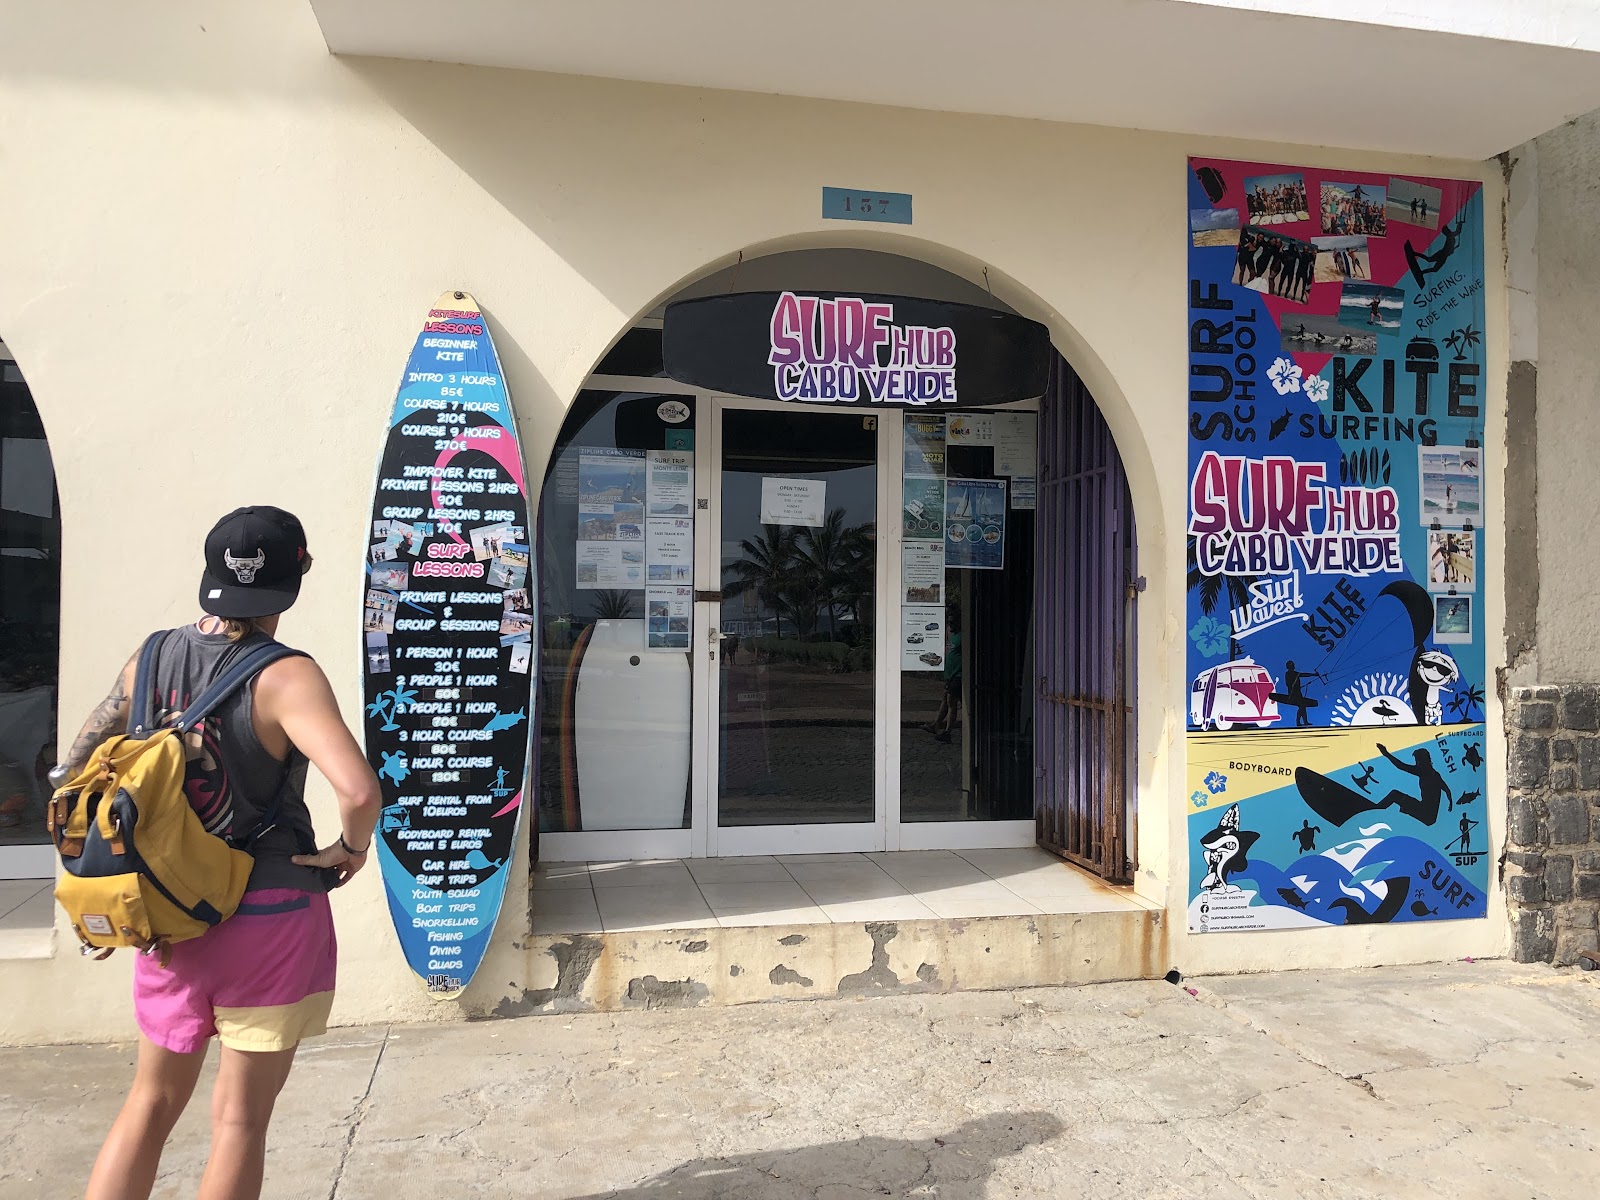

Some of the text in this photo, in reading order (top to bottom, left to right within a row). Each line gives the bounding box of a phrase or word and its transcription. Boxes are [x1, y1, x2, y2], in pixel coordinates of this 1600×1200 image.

[1416, 279, 1484, 330] RIDE THE WAVE
[428, 309, 480, 319] KITESURF
[424, 322, 482, 335] LESSONS
[769, 292, 955, 369] SURF HUB
[423, 339, 477, 350] BEGINNER
[436, 351, 464, 361] KITE
[1191, 279, 1233, 442] SURF
[409, 373, 496, 385] INTRO 3 HOURS
[1234, 308, 1256, 442] SCHOOL
[776, 363, 956, 404] CABO VERDE
[1332, 357, 1480, 417] KITE
[441, 387, 463, 397] 85€
[404, 399, 500, 411] COURSE 7 HOURS
[437, 413, 466, 424] 210€
[402, 425, 501, 438] COURSE 9 HOURS
[1300, 413, 1437, 443] SURFING
[434, 441, 467, 451] 270€
[403, 466, 497, 479] IMPROVER KITE
[381, 479, 518, 494] PRIVATE LESSONS 2HRS
[438, 495, 462, 506] 90€
[1190, 452, 1399, 537] SURF HUB
[383, 507, 515, 521] GROUP LESSONS 2HRS
[437, 523, 462, 533] 70€
[428, 543, 470, 558] SURF
[1199, 532, 1402, 575] CABO VERDE
[413, 562, 484, 577] LESSONS
[1248, 569, 1304, 608] Surf
[399, 591, 502, 604] PRIVATE LESSONS
[1301, 577, 1354, 641] KITE
[396, 620, 499, 632] GROUP SESSIONS
[1318, 589, 1366, 652] SURF
[396, 647, 498, 659] 1 PERSON 1 HOUR
[434, 662, 460, 672] 30€
[396, 675, 497, 686] 2 PEOPLE 1 HOUR
[397, 702, 497, 714] 3 PEOPLE 1 HOUR
[399, 730, 493, 741] 3 HOUR COURSE
[1435, 732, 1457, 773] LEASH
[399, 757, 493, 769] 5 HOUR COURSE
[1229, 761, 1292, 777] BODYBOARD
[398, 795, 492, 806] SURF RENTAL FROM
[398, 829, 492, 839] BODYBOARD RENTAL
[407, 839, 482, 850] FROM 5 EUROS
[422, 860, 470, 871] CAR HIRE
[1455, 856, 1478, 866] SUP
[416, 874, 477, 885] SURF TRIPS
[1418, 860, 1476, 910] SURF
[412, 889, 480, 899] YOUTH SQUAD
[416, 903, 475, 913] BOAT TRIPS
[412, 918, 478, 928] SNORKELLING
[428, 932, 463, 941] FISHING
[429, 946, 461, 955] DIVING
[428, 960, 463, 970] QUADS
